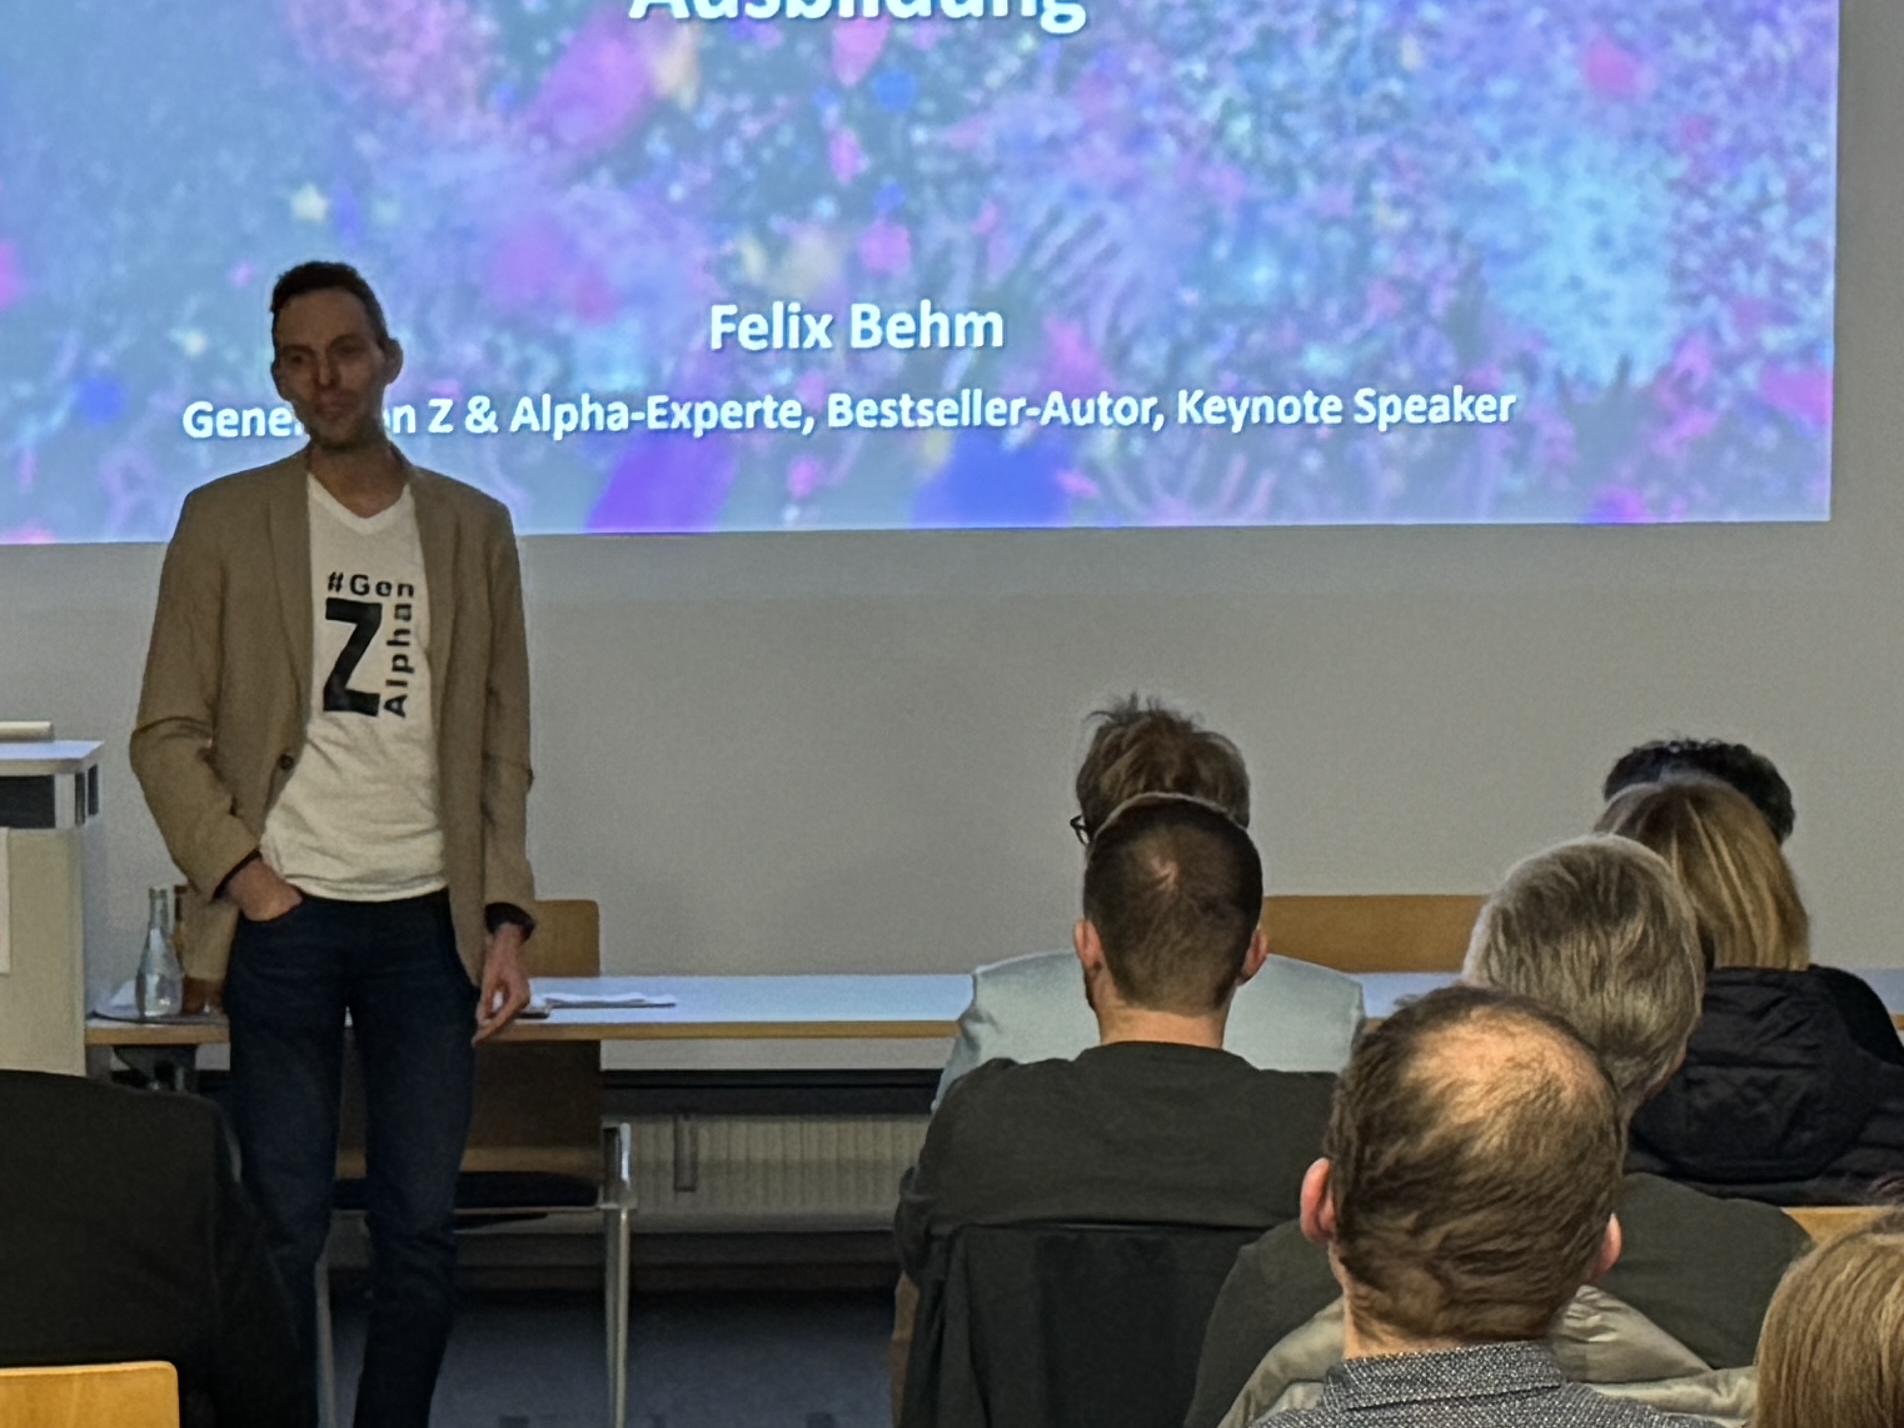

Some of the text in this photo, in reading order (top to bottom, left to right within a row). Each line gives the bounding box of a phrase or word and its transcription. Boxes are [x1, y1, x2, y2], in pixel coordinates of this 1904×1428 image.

[709, 298, 1005, 352] Felix Behm
[427, 398, 455, 434] Z
[464, 394, 499, 434] &
[509, 392, 816, 441] Alpha-Experte,
[827, 387, 1165, 432] Bestseller-Autor,
[1176, 388, 1344, 434] Keynote
[1352, 385, 1518, 432] Speaker
[326, 571, 415, 598] #Gen
[323, 596, 383, 717] Z
[383, 602, 416, 719] Alpha
